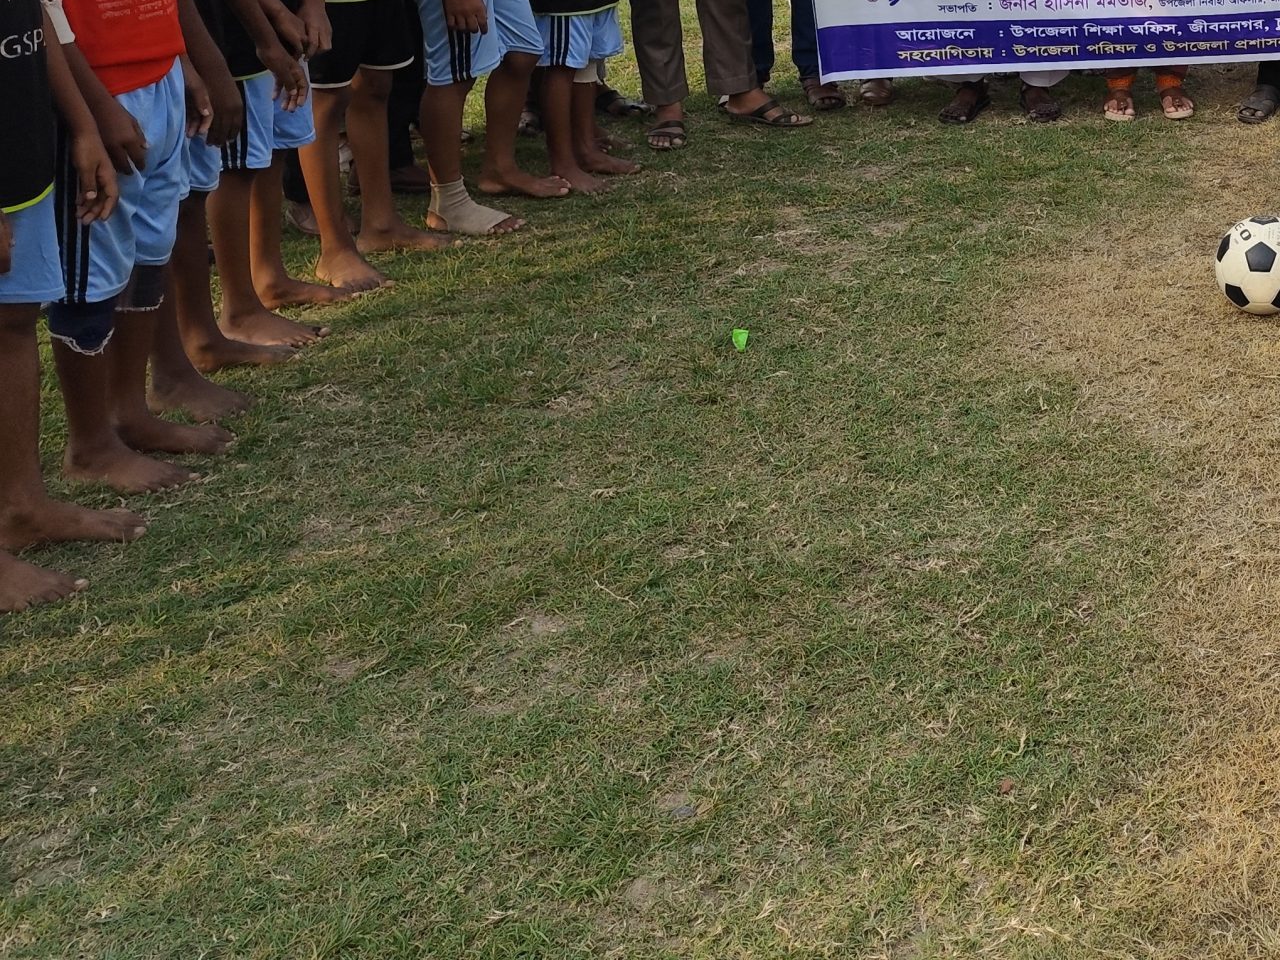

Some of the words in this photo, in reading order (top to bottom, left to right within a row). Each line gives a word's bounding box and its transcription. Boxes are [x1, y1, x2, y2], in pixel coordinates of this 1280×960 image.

[938, 3, 978, 14] সভাপতি
[895, 28, 975, 41] আয়োজনে
[1010, 24, 1077, 38] উপজেলা
[1082, 22, 1123, 37] শিক্ষা
[1128, 20, 1182, 36] অফিস,
[1188, 18, 1270, 34] জীবননগর,
[0, 28, 43, 59] GSP
[897, 44, 994, 62] সহযোগিতায়
[1012, 43, 1079, 57] উপজেলা
[1086, 41, 1137, 55] পরিষদ
[1144, 44, 1156, 53] ও
[1163, 38, 1228, 53] উপজেলা
